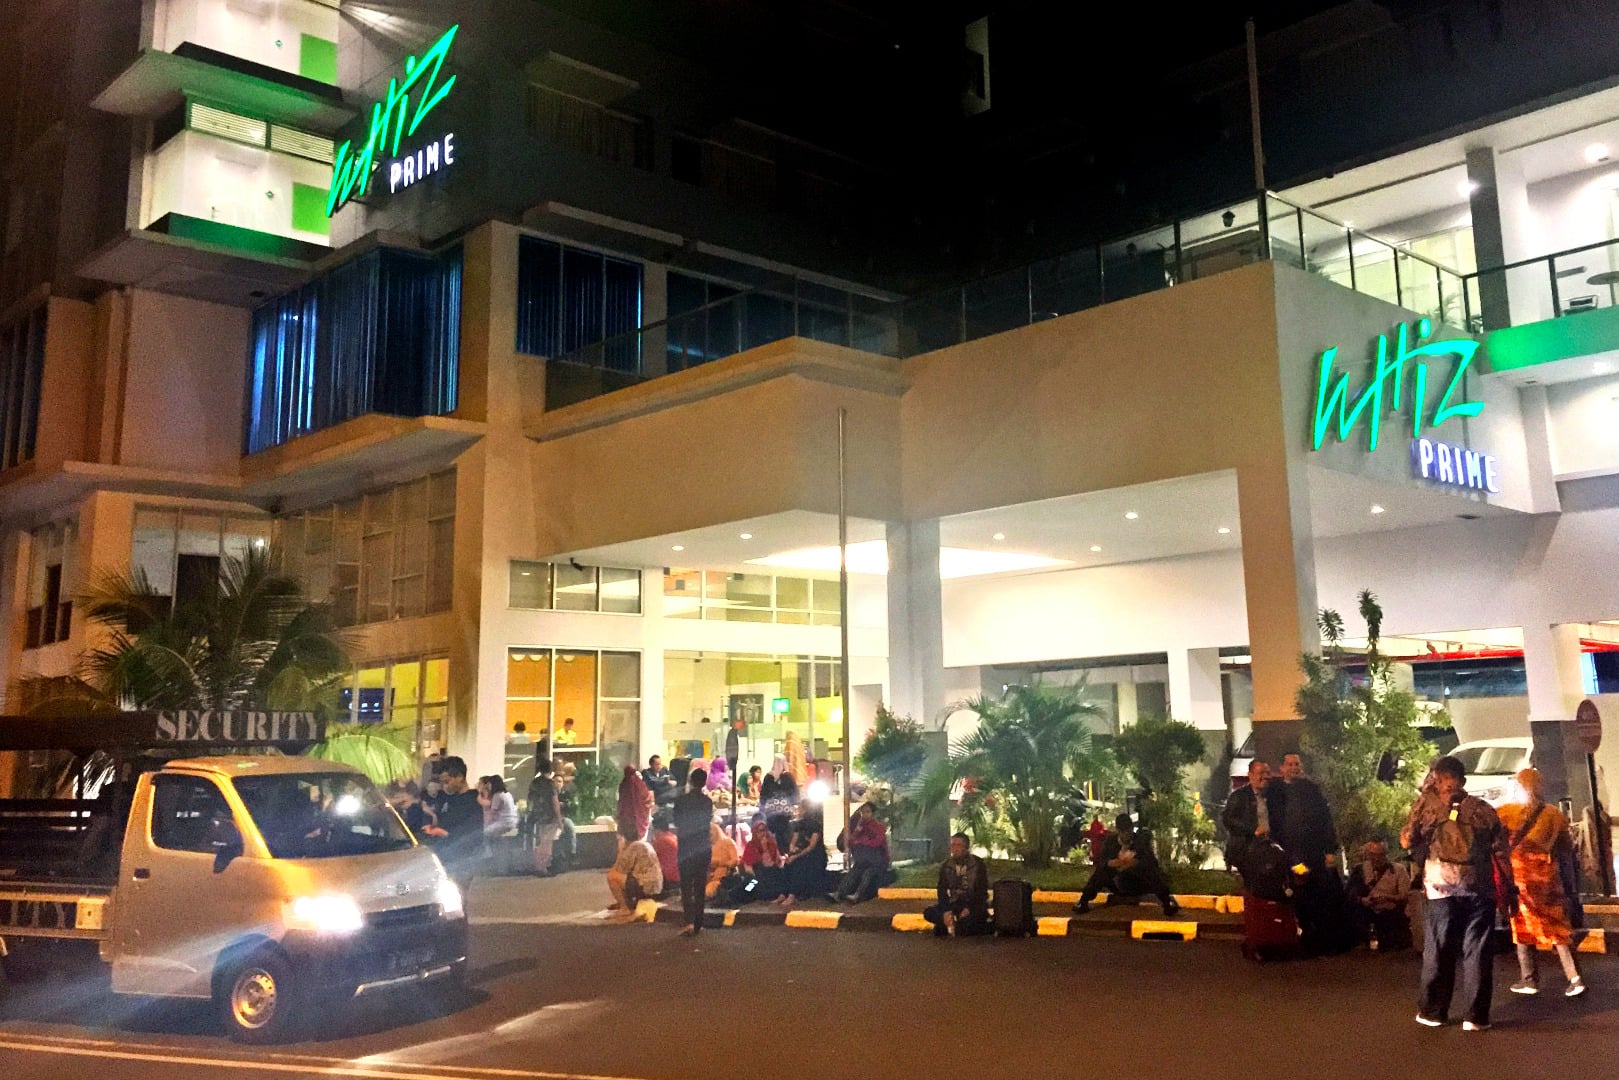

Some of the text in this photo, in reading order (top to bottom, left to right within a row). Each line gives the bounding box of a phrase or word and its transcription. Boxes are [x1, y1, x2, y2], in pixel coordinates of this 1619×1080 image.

[390, 132, 454, 194] PRIME
[1417, 438, 1499, 493] PRIME
[155, 709, 318, 741] SECURITY
